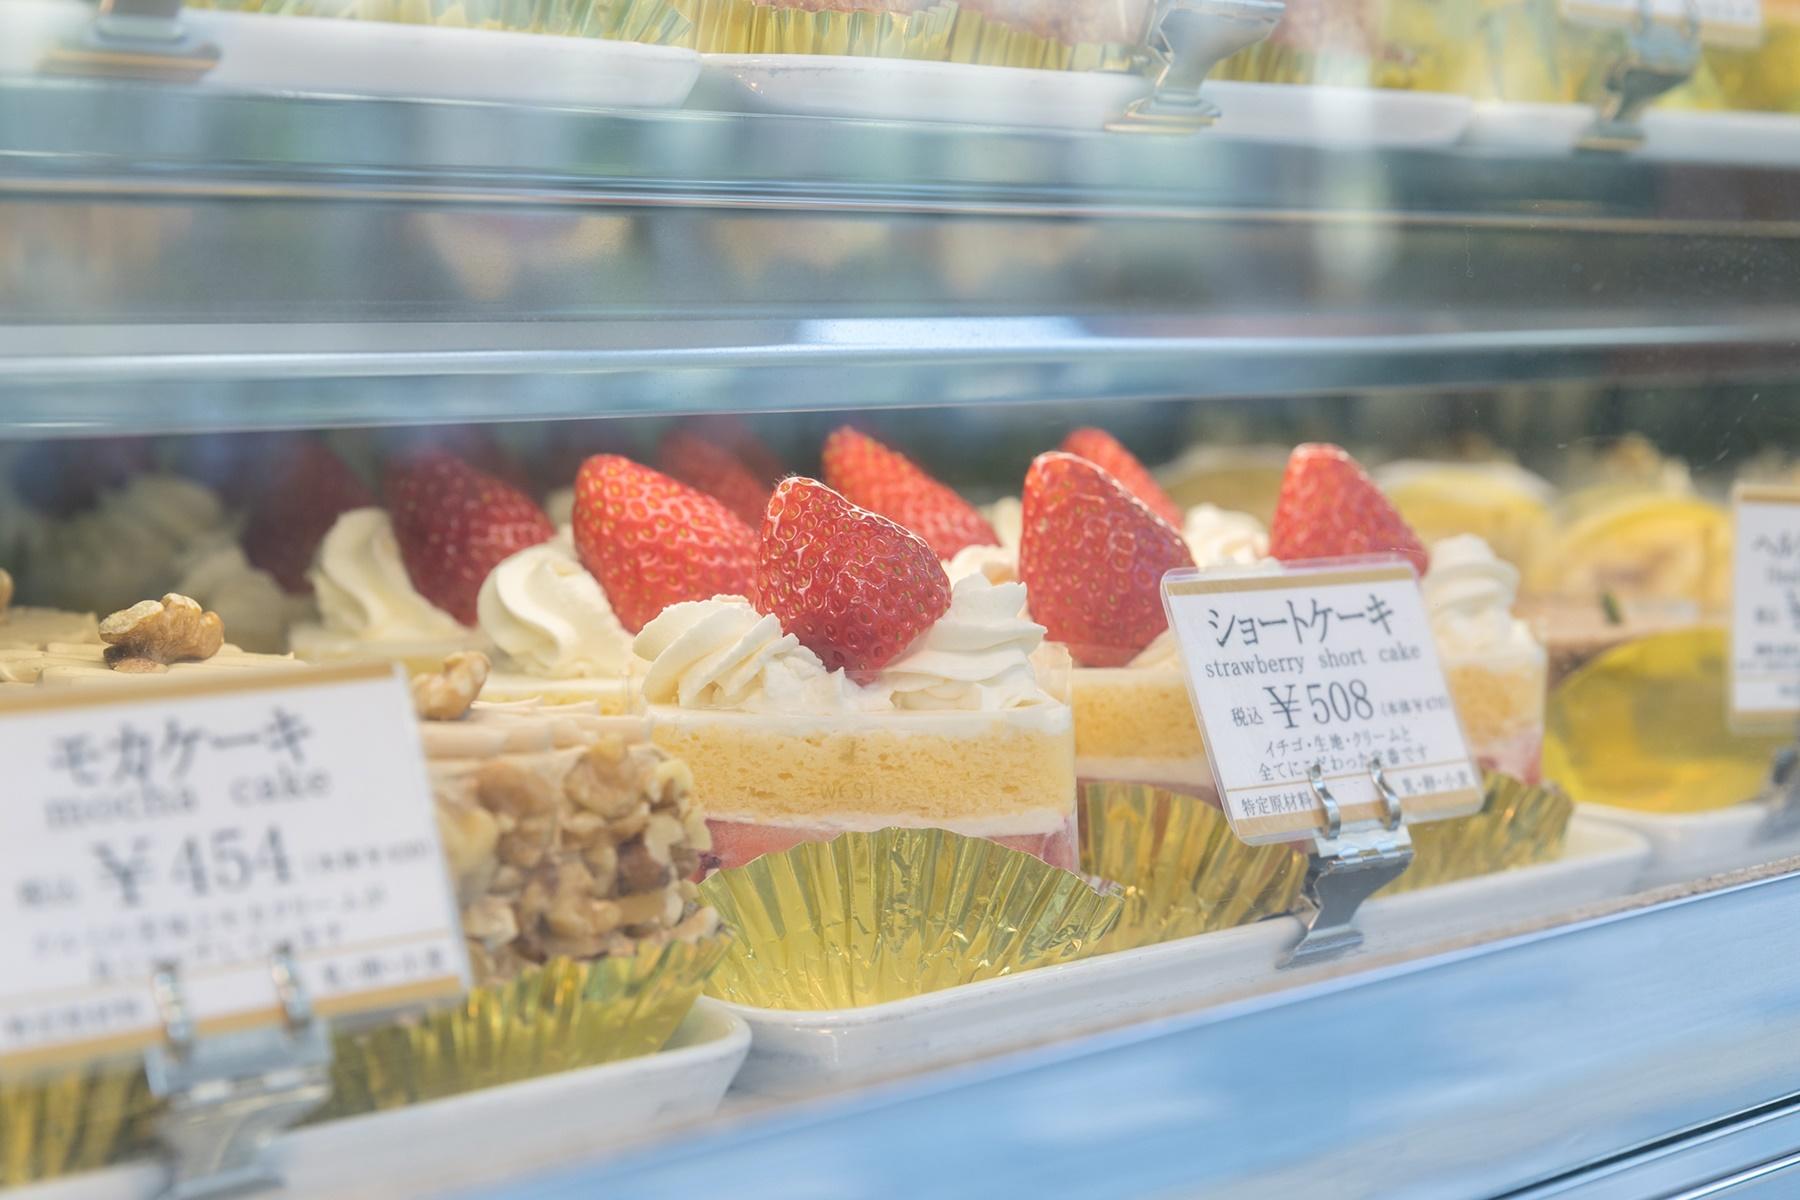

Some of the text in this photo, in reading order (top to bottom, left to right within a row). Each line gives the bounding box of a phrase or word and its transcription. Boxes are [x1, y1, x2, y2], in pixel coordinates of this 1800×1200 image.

[1208, 593, 1394, 647] ショートケーキ
[1205, 641, 1422, 679] strawberry short cake
[1231, 706, 1265, 727] 税込
[1262, 679, 1375, 729] ¥508
[51, 707, 313, 787] モカケーキ
[45, 765, 332, 829] mocha cake
[1241, 791, 1313, 817] 特定原材料
[91, 826, 292, 908] ¥454
